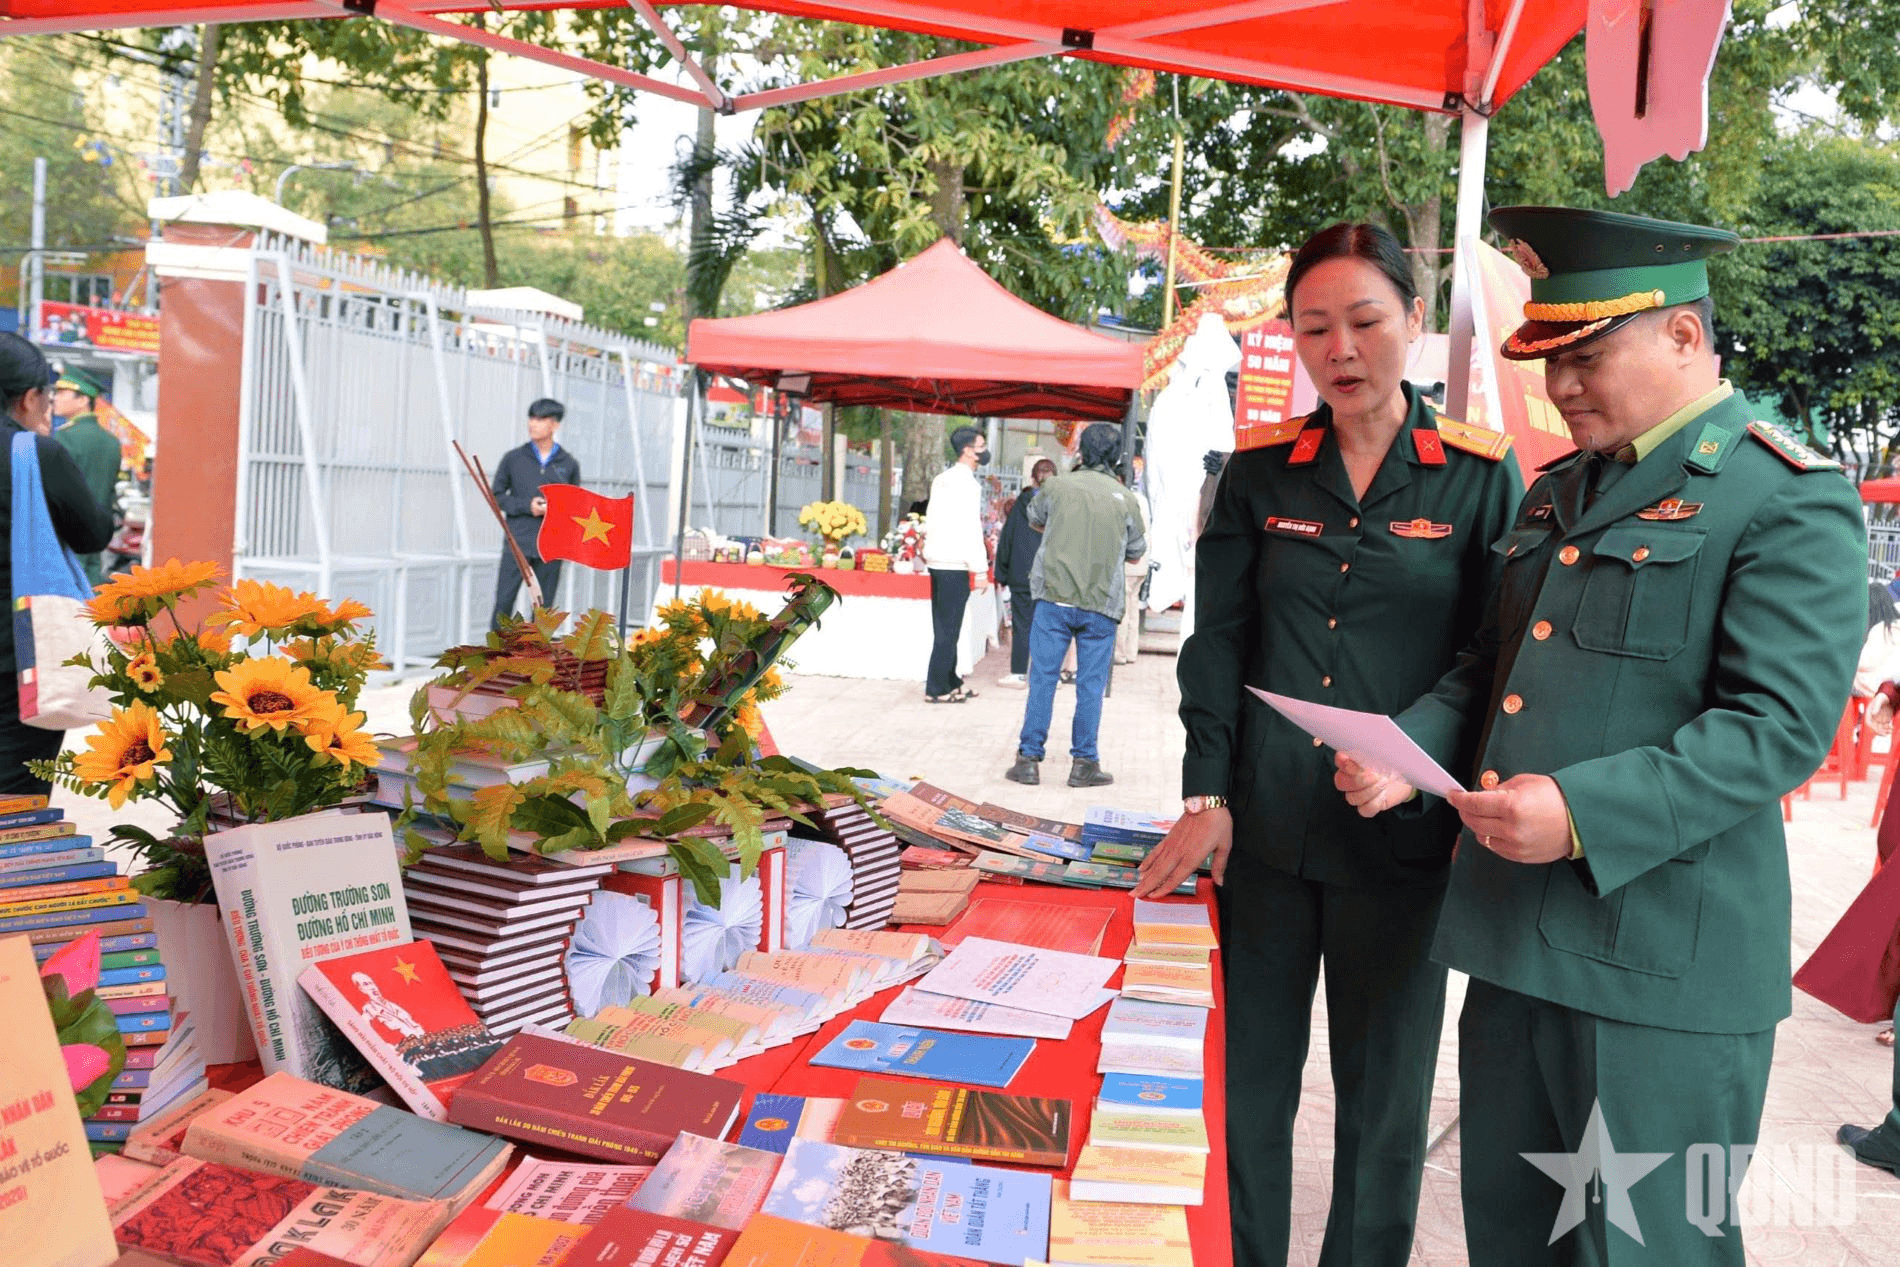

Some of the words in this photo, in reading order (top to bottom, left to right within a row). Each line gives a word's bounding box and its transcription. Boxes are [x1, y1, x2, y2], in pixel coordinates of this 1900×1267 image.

[241, 889, 257, 919] ĐƯỜNG
[292, 891, 329, 916] ĐƯỜNG
[329, 884, 370, 911] TRƯỜNG
[370, 882, 392, 901] SƠN
[248, 919, 265, 953] TRƯỜNG
[297, 916, 334, 941] ĐƯỜNG
[335, 908, 350, 933] HỒ
[351, 908, 368, 930] CHÍ
[370, 906, 396, 927] MINH
[254, 953, 268, 973] SƠN
[259, 977, 276, 1008] ĐƯỜNG
[266, 1008, 281, 1021] HỒ
[269, 1020, 285, 1038] CHÍ
[272, 1037, 286, 1062] MINH
[44, 1141, 70, 1162] QUỐC
